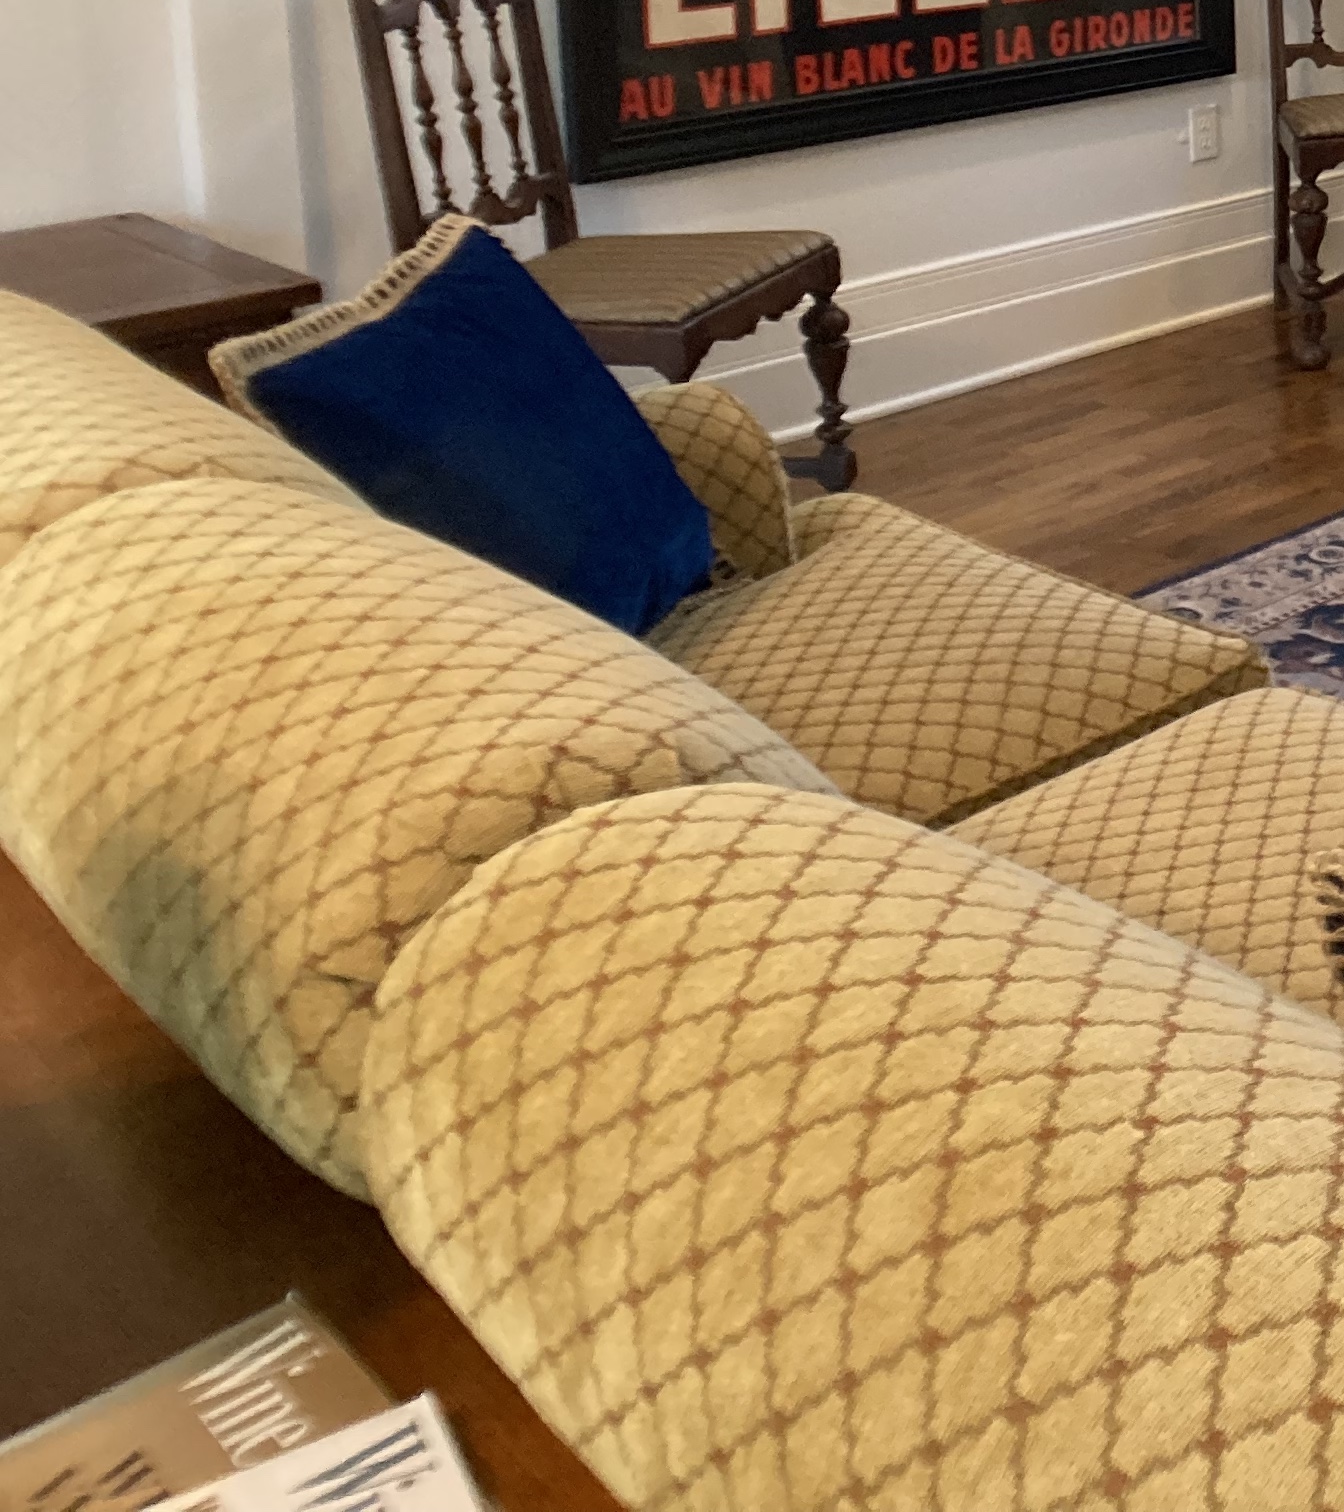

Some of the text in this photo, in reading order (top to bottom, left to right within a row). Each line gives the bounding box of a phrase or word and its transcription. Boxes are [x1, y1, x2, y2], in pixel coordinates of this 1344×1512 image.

[618, 2, 1196, 123] AU VIN BLANC DE LA GIRONDE
[177, 1316, 328, 1470] Wine
